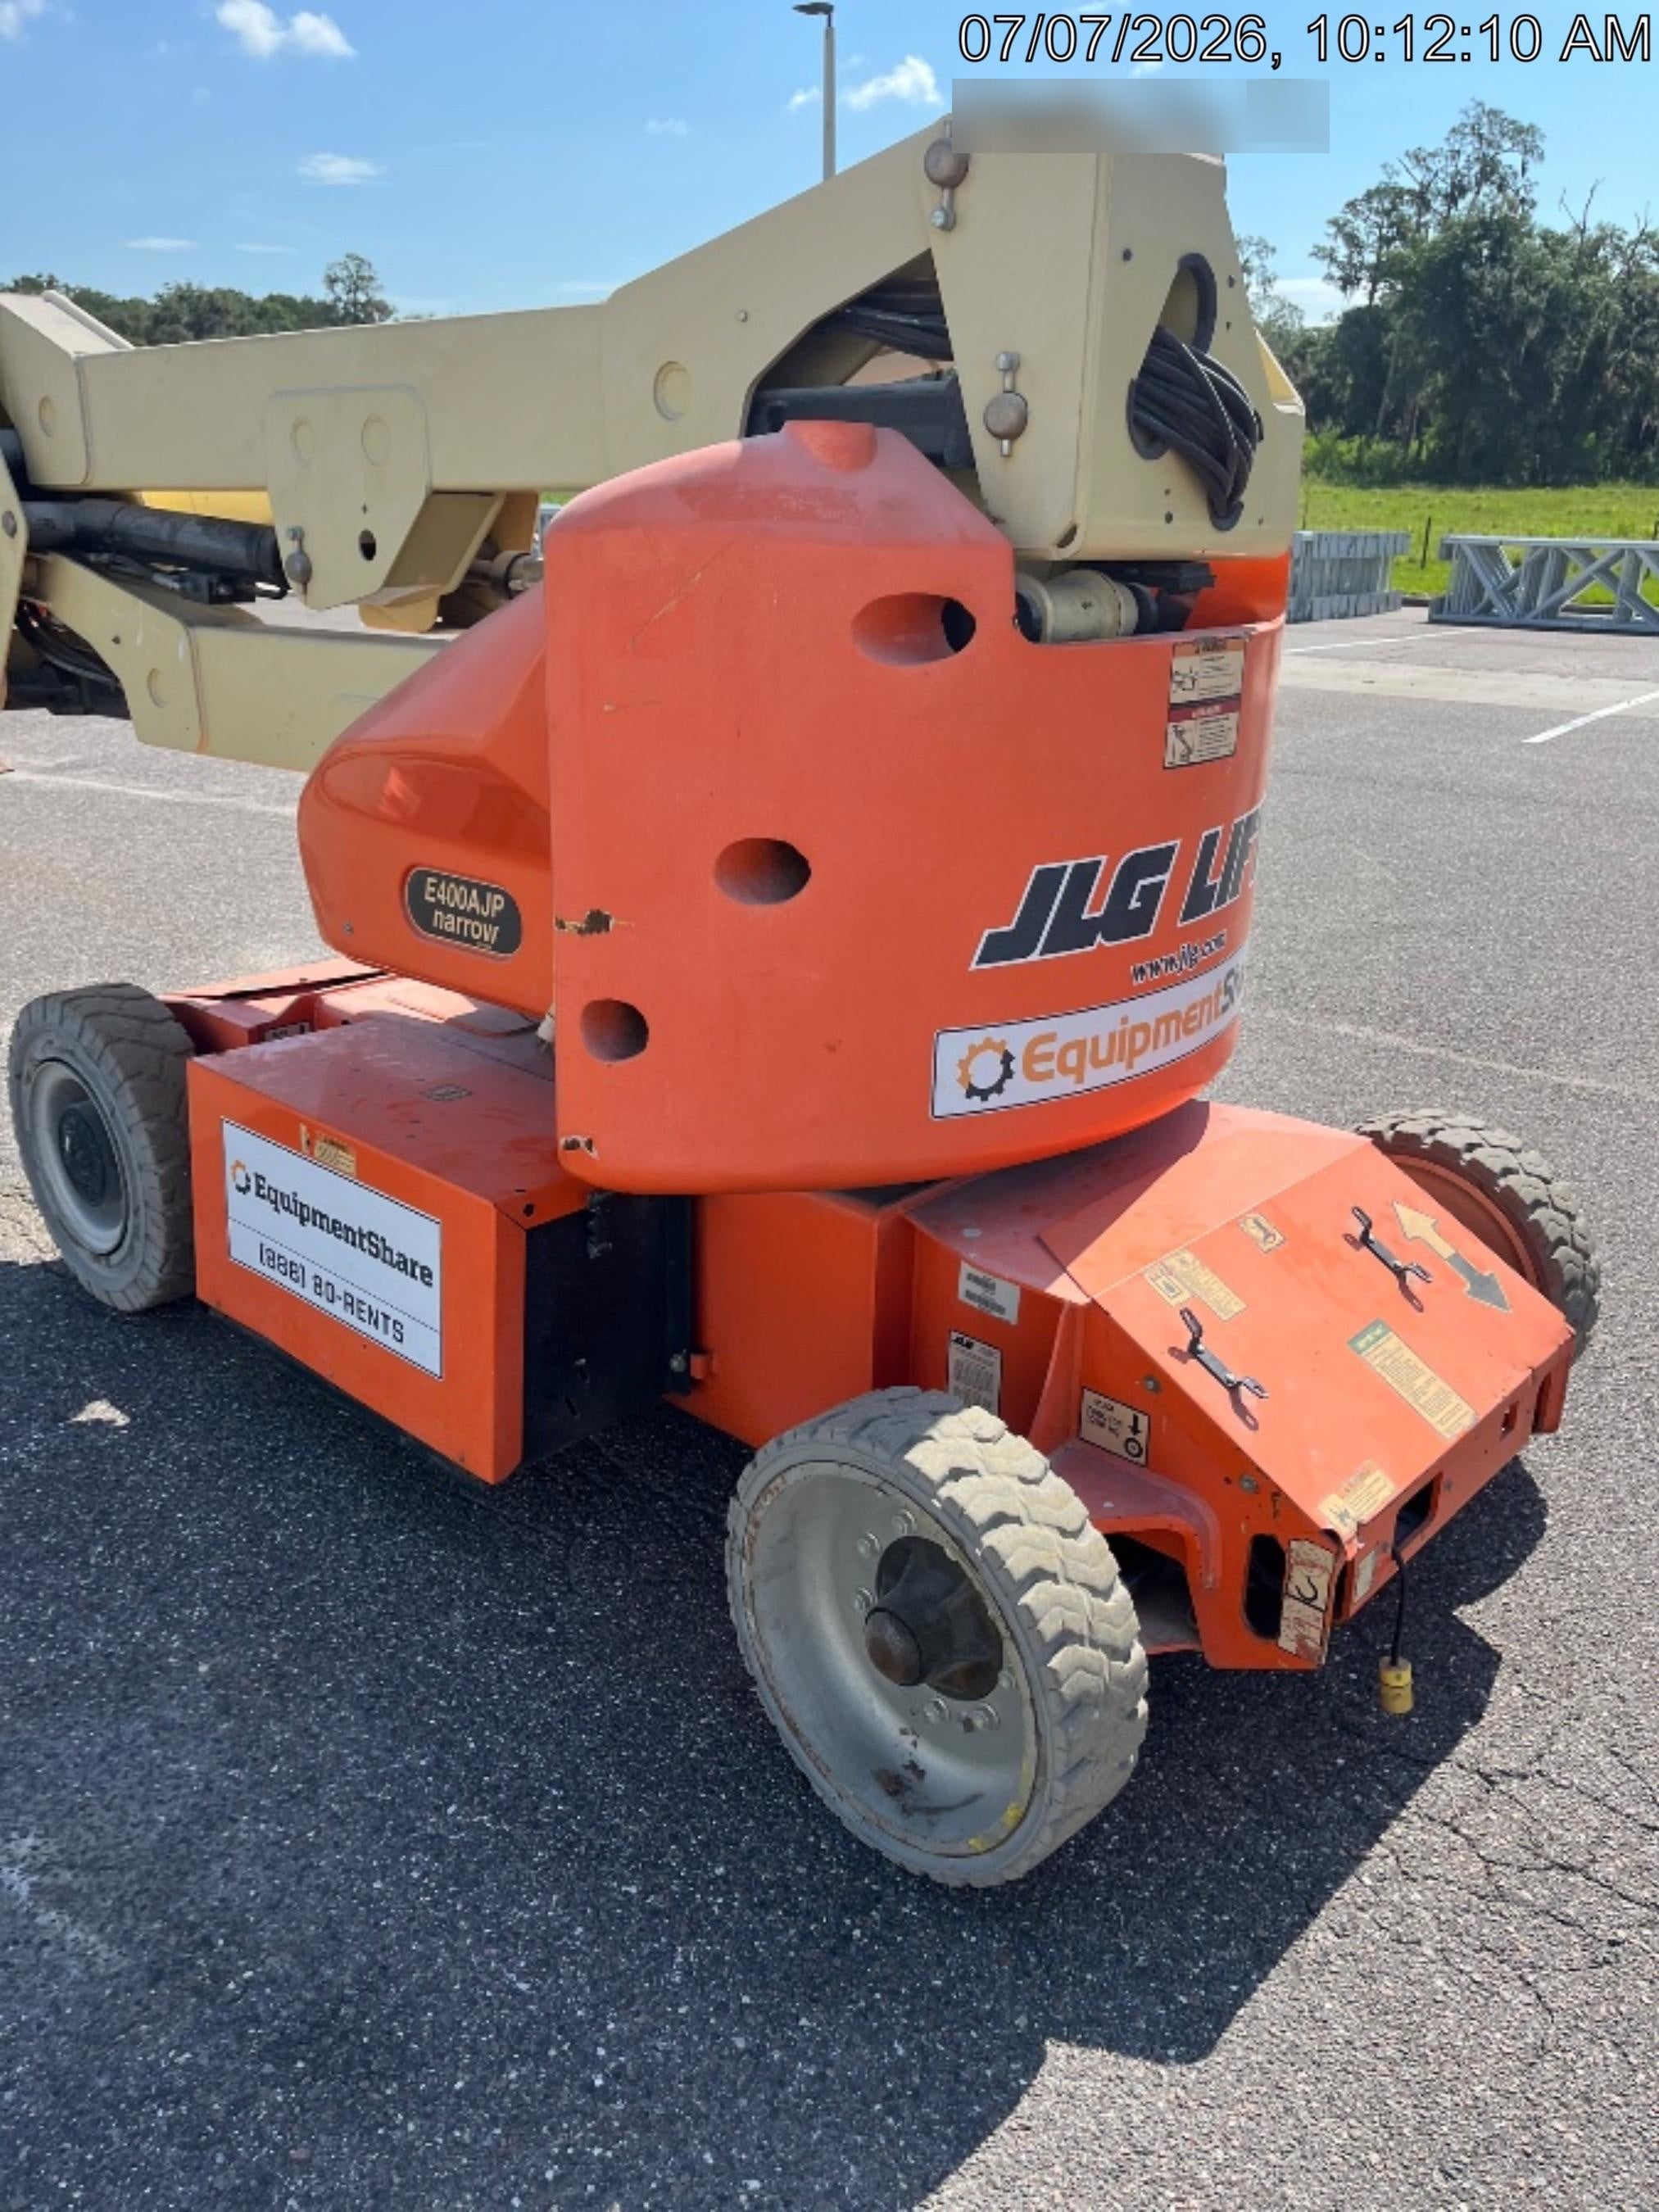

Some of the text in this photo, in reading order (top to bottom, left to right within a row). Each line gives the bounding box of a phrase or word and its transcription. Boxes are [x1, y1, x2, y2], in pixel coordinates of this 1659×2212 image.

[424, 877, 505, 918] E400AJP
[433, 909, 499, 944] narrow
[970, 841, 1181, 969] JLG
[255, 1172, 434, 1287] EquipmentShare
[312, 1275, 404, 1344] 80-RENTS
